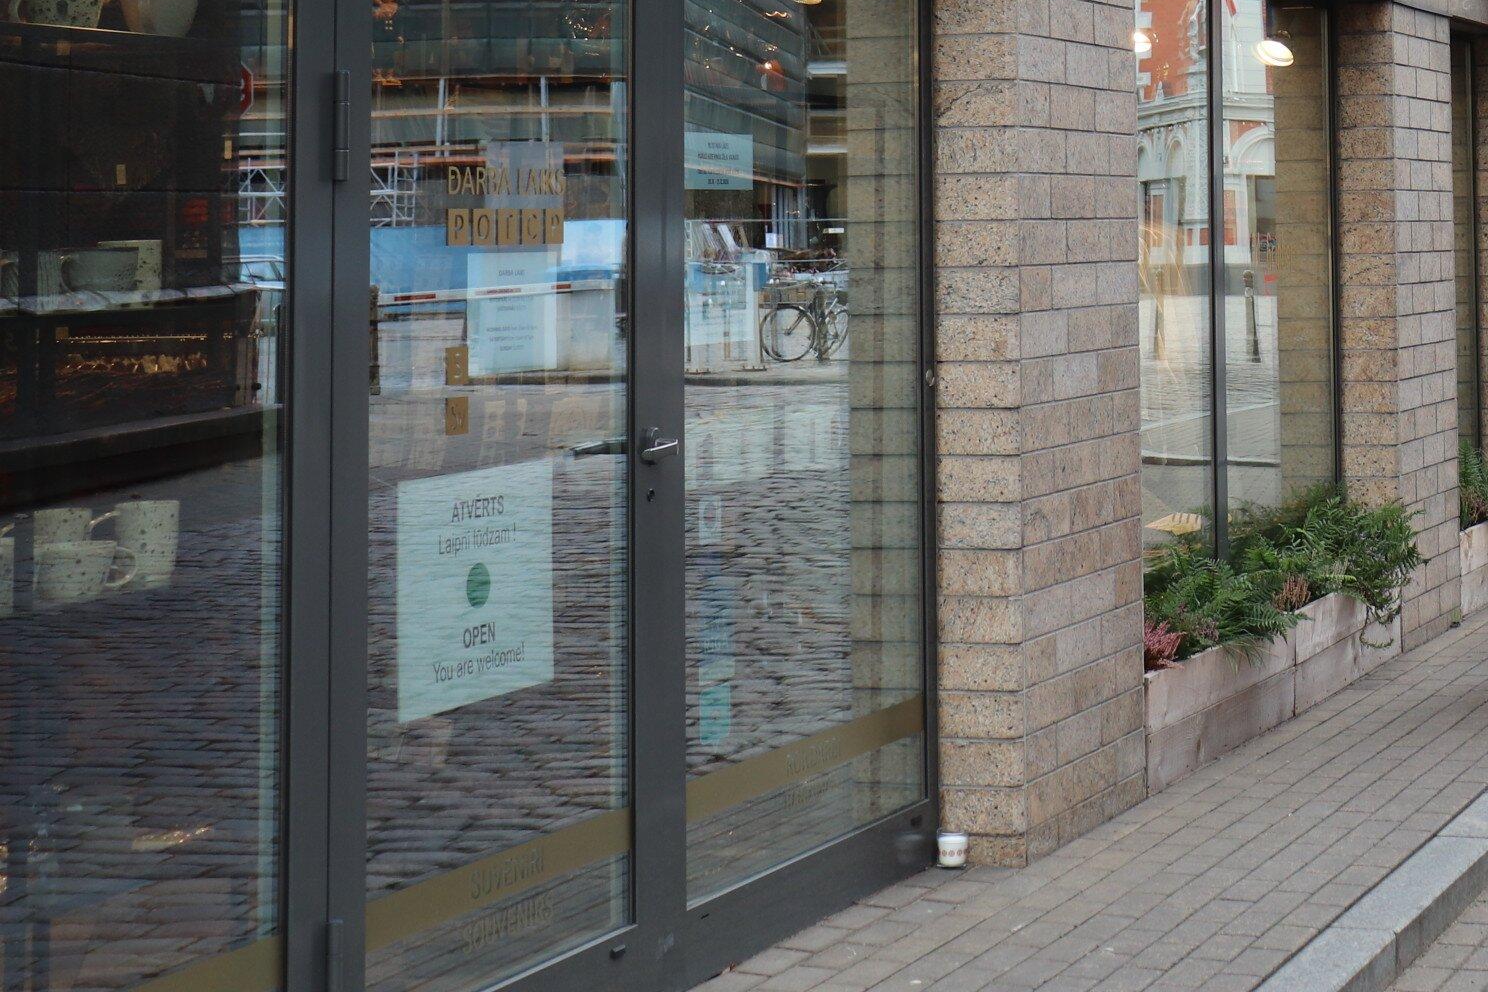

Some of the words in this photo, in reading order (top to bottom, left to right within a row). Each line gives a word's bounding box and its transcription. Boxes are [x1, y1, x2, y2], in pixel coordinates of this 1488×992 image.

[448, 166, 511, 195] DARBA
[463, 621, 495, 648] OPEN
[433, 661, 453, 684] You
[456, 659, 474, 678] are
[477, 640, 525, 672] welcome!
